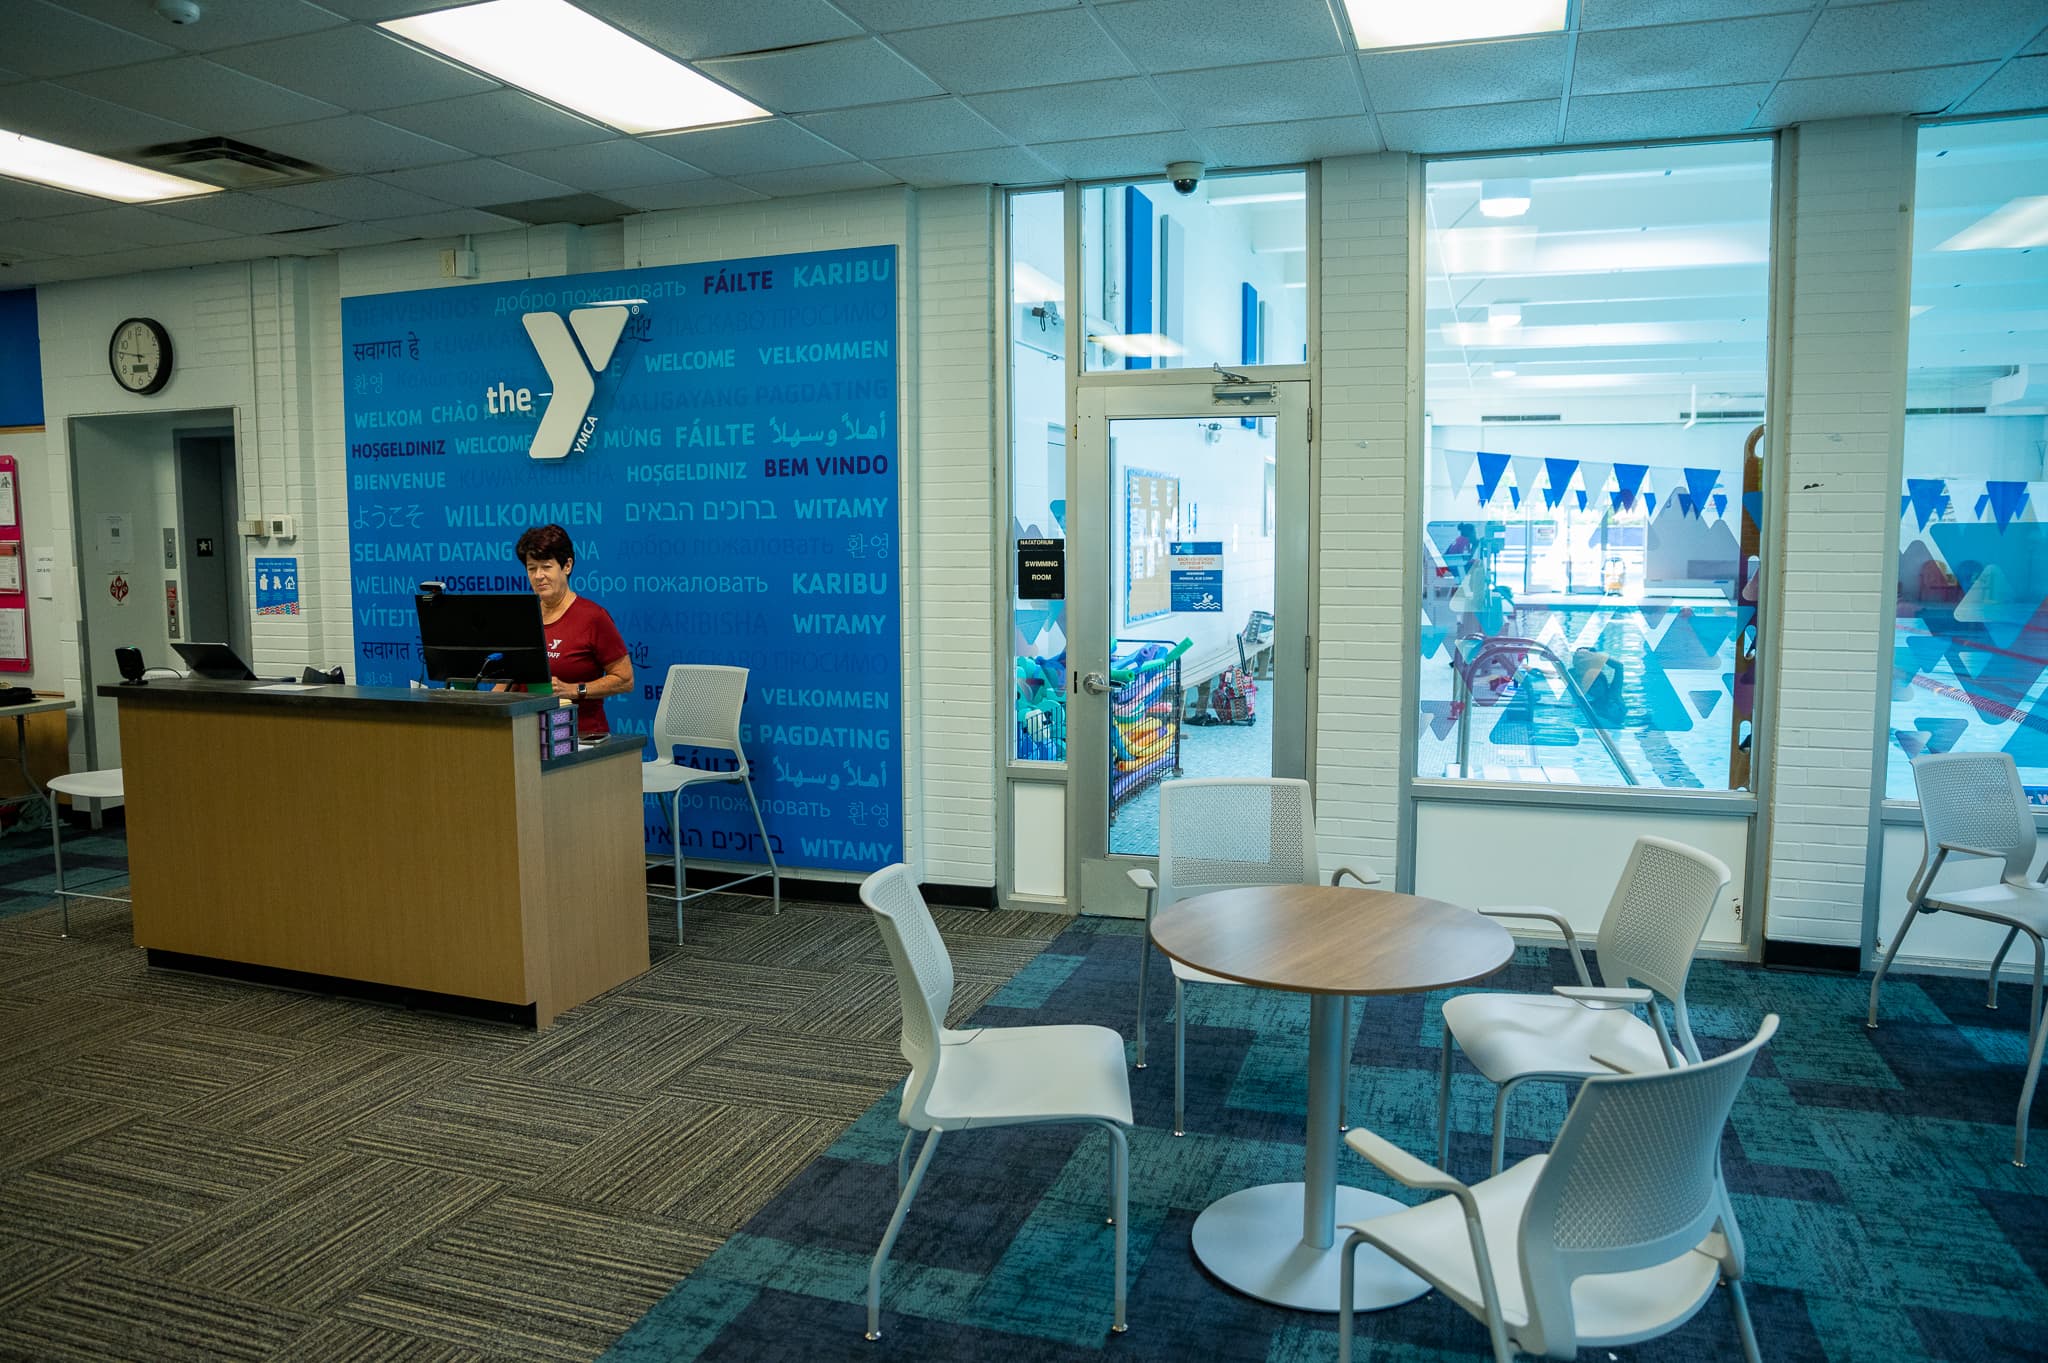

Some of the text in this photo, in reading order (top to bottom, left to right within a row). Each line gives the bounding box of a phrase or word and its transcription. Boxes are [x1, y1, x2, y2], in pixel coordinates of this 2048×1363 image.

[703, 268, 774, 295] FÁILTE
[793, 258, 890, 289] KARIBU
[645, 349, 735, 374] WELCOME
[758, 340, 889, 365] VELKOMMEN
[486, 382, 532, 415] the
[354, 409, 422, 429] WELKOM
[431, 399, 478, 424] CHÀO
[573, 415, 599, 454] YMCA
[675, 418, 755, 448] FÁILTE
[351, 439, 446, 462] HOŞGELDINIZ
[627, 461, 748, 487] HOŞGELDINIZ
[764, 454, 888, 478] BEM VINDO
[353, 471, 446, 491] BIENVENUE
[353, 504, 425, 529] ようこそ
[444, 502, 602, 528] WILLKOMMEN
[794, 497, 888, 520] WITAMY
[354, 541, 513, 562] SELAMAT DATANG
[1024, 560, 1059, 568] SWIMMING
[355, 575, 417, 595] WELINA
[435, 575, 534, 594] OŞGELDINI
[569, 569, 769, 598] обро пожаловать
[792, 572, 887, 596] KARIBU
[359, 602, 417, 628] VÍTEJT
[793, 613, 886, 635] WITAMY
[626, 641, 653, 668] 迎
[761, 687, 889, 710] VELKOMMEN
[760, 724, 890, 750] PAGDATING
[709, 794, 831, 818] пожловать
[800, 836, 893, 863] WITAMY
